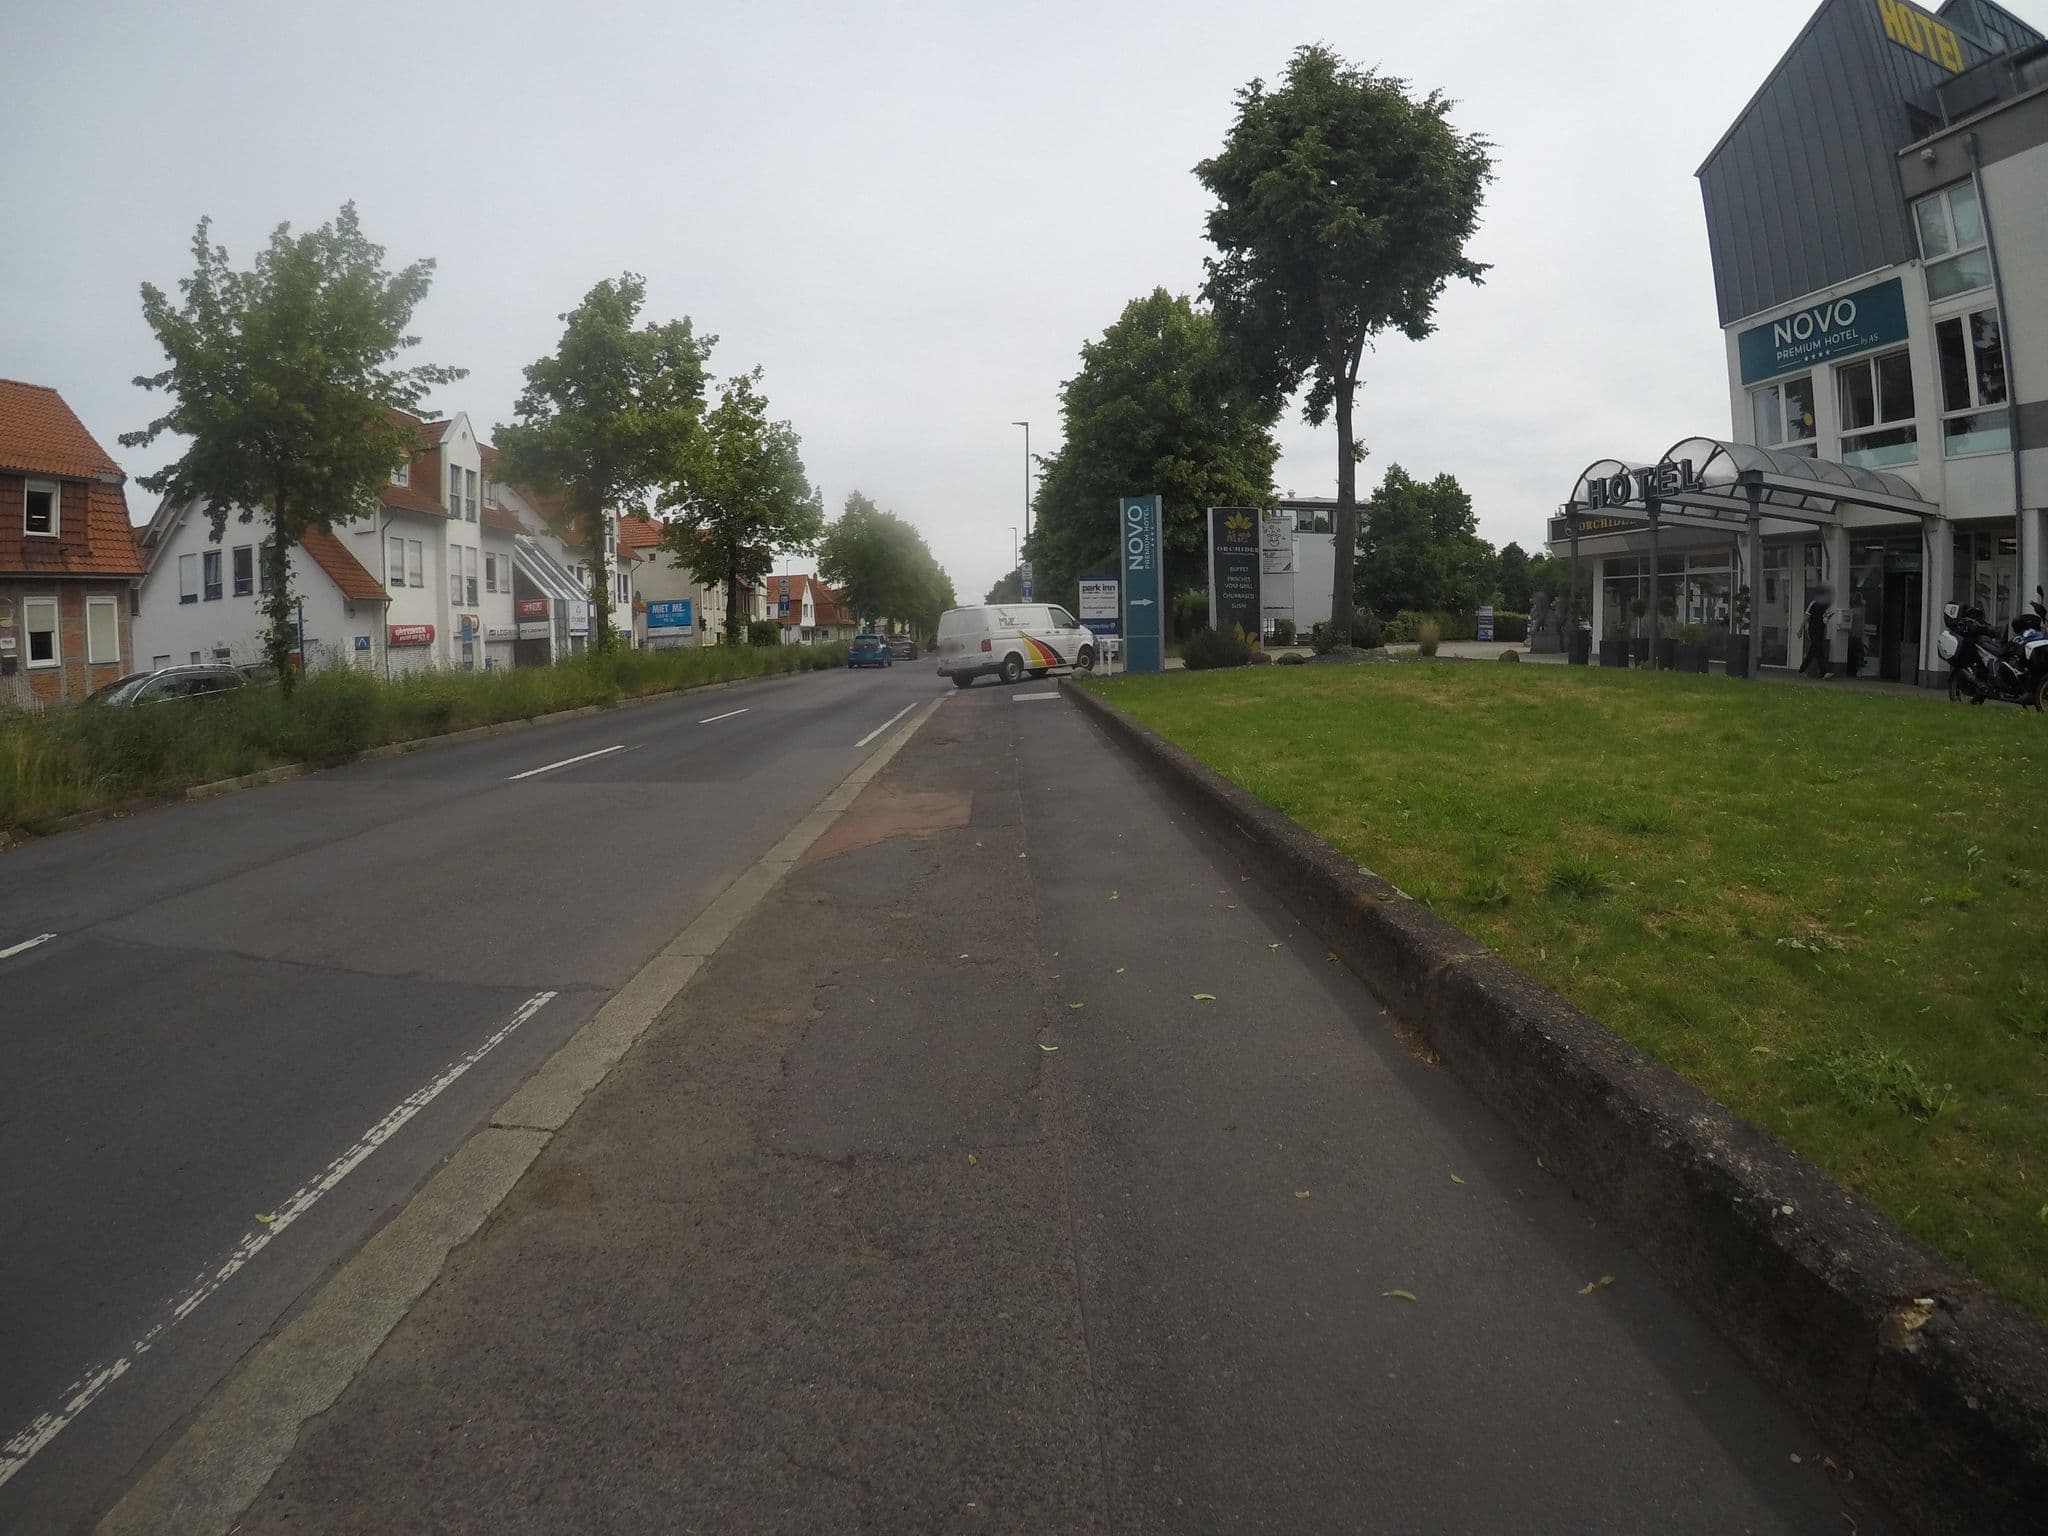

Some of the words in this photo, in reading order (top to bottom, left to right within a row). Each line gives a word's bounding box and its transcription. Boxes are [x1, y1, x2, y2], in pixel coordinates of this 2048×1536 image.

[1774, 299, 1857, 348] NOVO
[1776, 339, 1821, 361] PREMIUM
[1824, 328, 1859, 346] HOTEL
[1588, 459, 1704, 509] HOTEL
[1128, 505, 1144, 570] NOVO
[1082, 584, 1101, 592] park
[1102, 583, 1116, 591] inn
